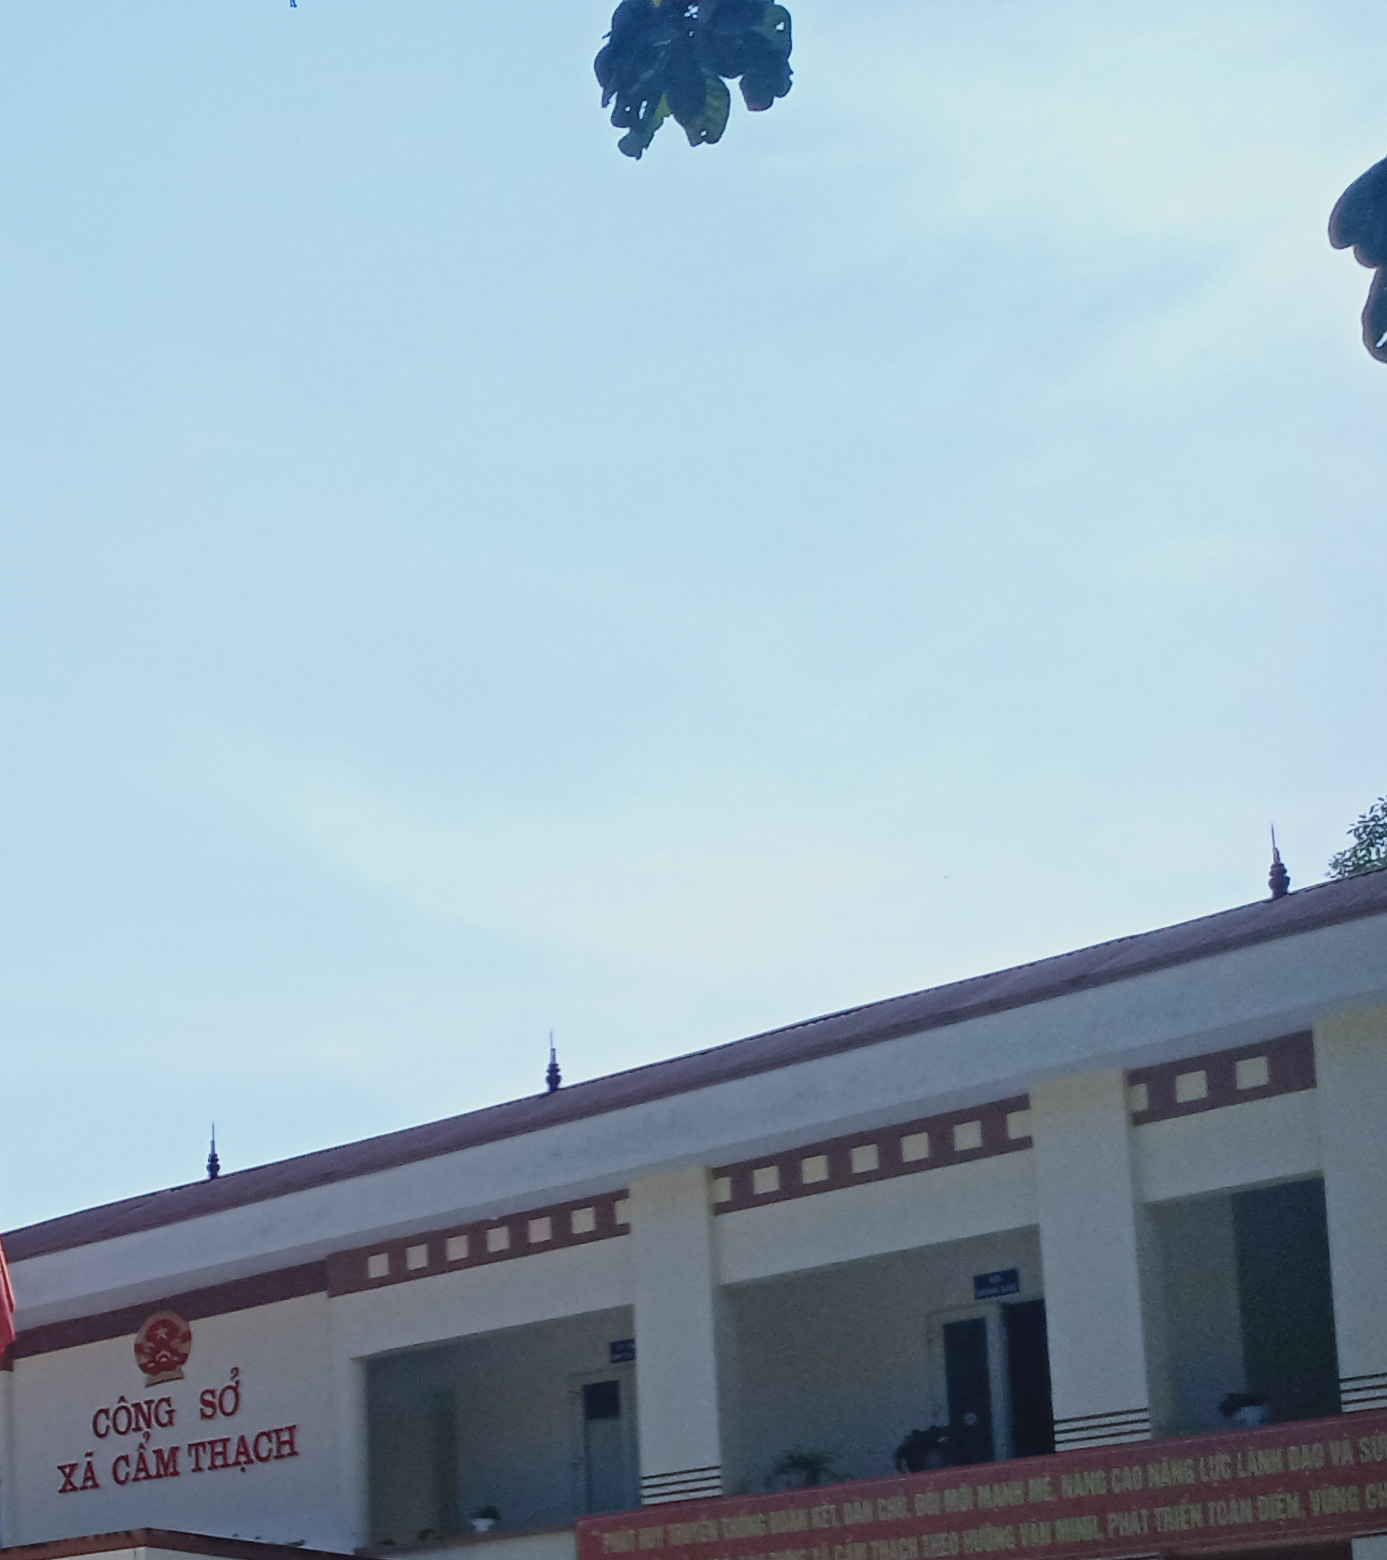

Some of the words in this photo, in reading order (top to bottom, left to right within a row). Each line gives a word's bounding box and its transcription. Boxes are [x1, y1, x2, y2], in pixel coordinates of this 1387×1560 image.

[92, 1395, 176, 1438] CÔNG
[200, 1367, 240, 1420] SỞ
[57, 1451, 99, 1493] XÃ
[112, 1431, 179, 1486] CẨM
[188, 1424, 298, 1473] THẠCH
[1061, 1466, 1106, 1498] NÂNG
[1110, 1464, 1142, 1492] CAO
[1147, 1455, 1194, 1488] NĂNG
[1199, 1452, 1231, 1485] LỰC
[1237, 1443, 1282, 1477] LÃNH
[1286, 1440, 1324, 1474] ĐẠO
[1329, 1433, 1354, 1466] VÀ
[1107, 1506, 1149, 1538] PHÁT
[1153, 1498, 1203, 1533] TRIỂN
[1207, 1494, 1253, 1527] TOÀN
